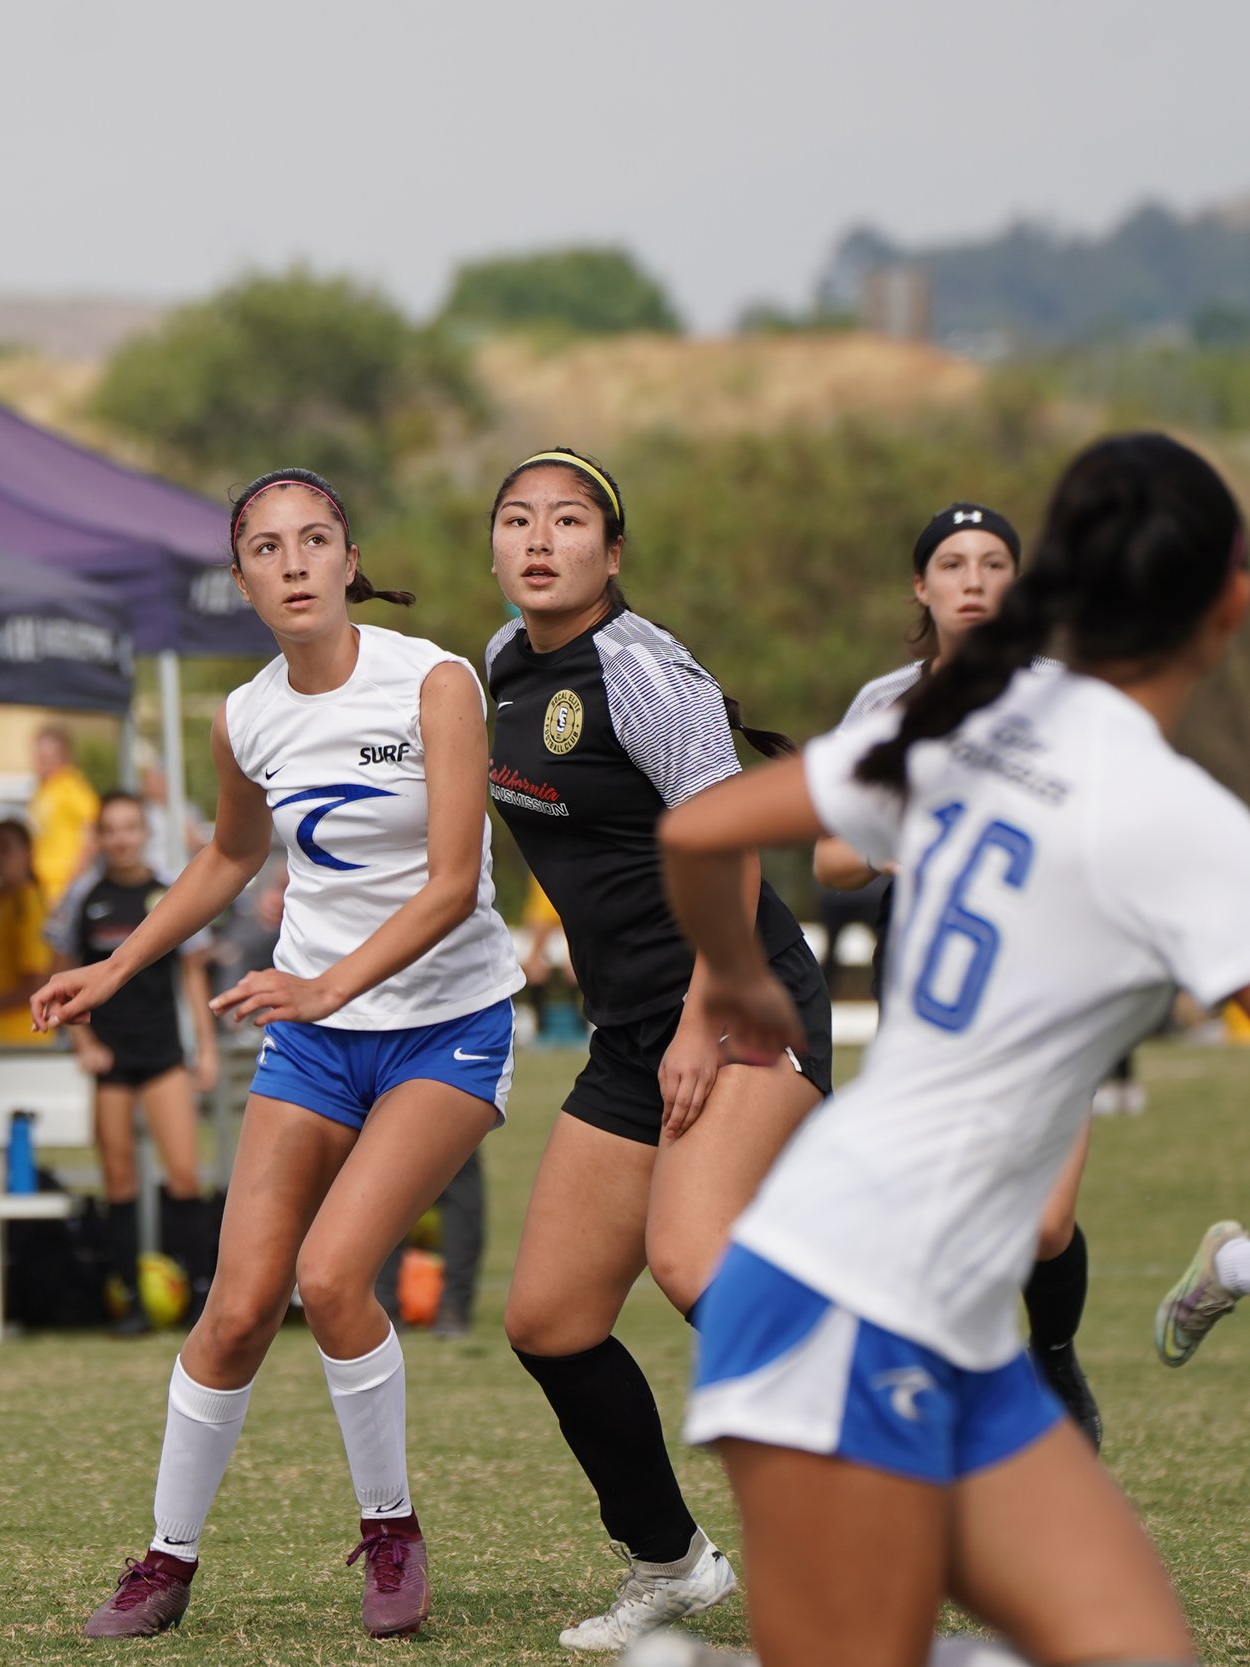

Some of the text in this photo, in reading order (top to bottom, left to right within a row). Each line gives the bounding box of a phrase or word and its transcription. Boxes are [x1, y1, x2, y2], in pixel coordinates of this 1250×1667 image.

[358, 742, 411, 766] SURF
[564, 731, 579, 752] CLUB
[489, 758, 560, 802] alifornia
[489, 781, 570, 817] ANSMISSION
[893, 801, 1035, 1037] 16
